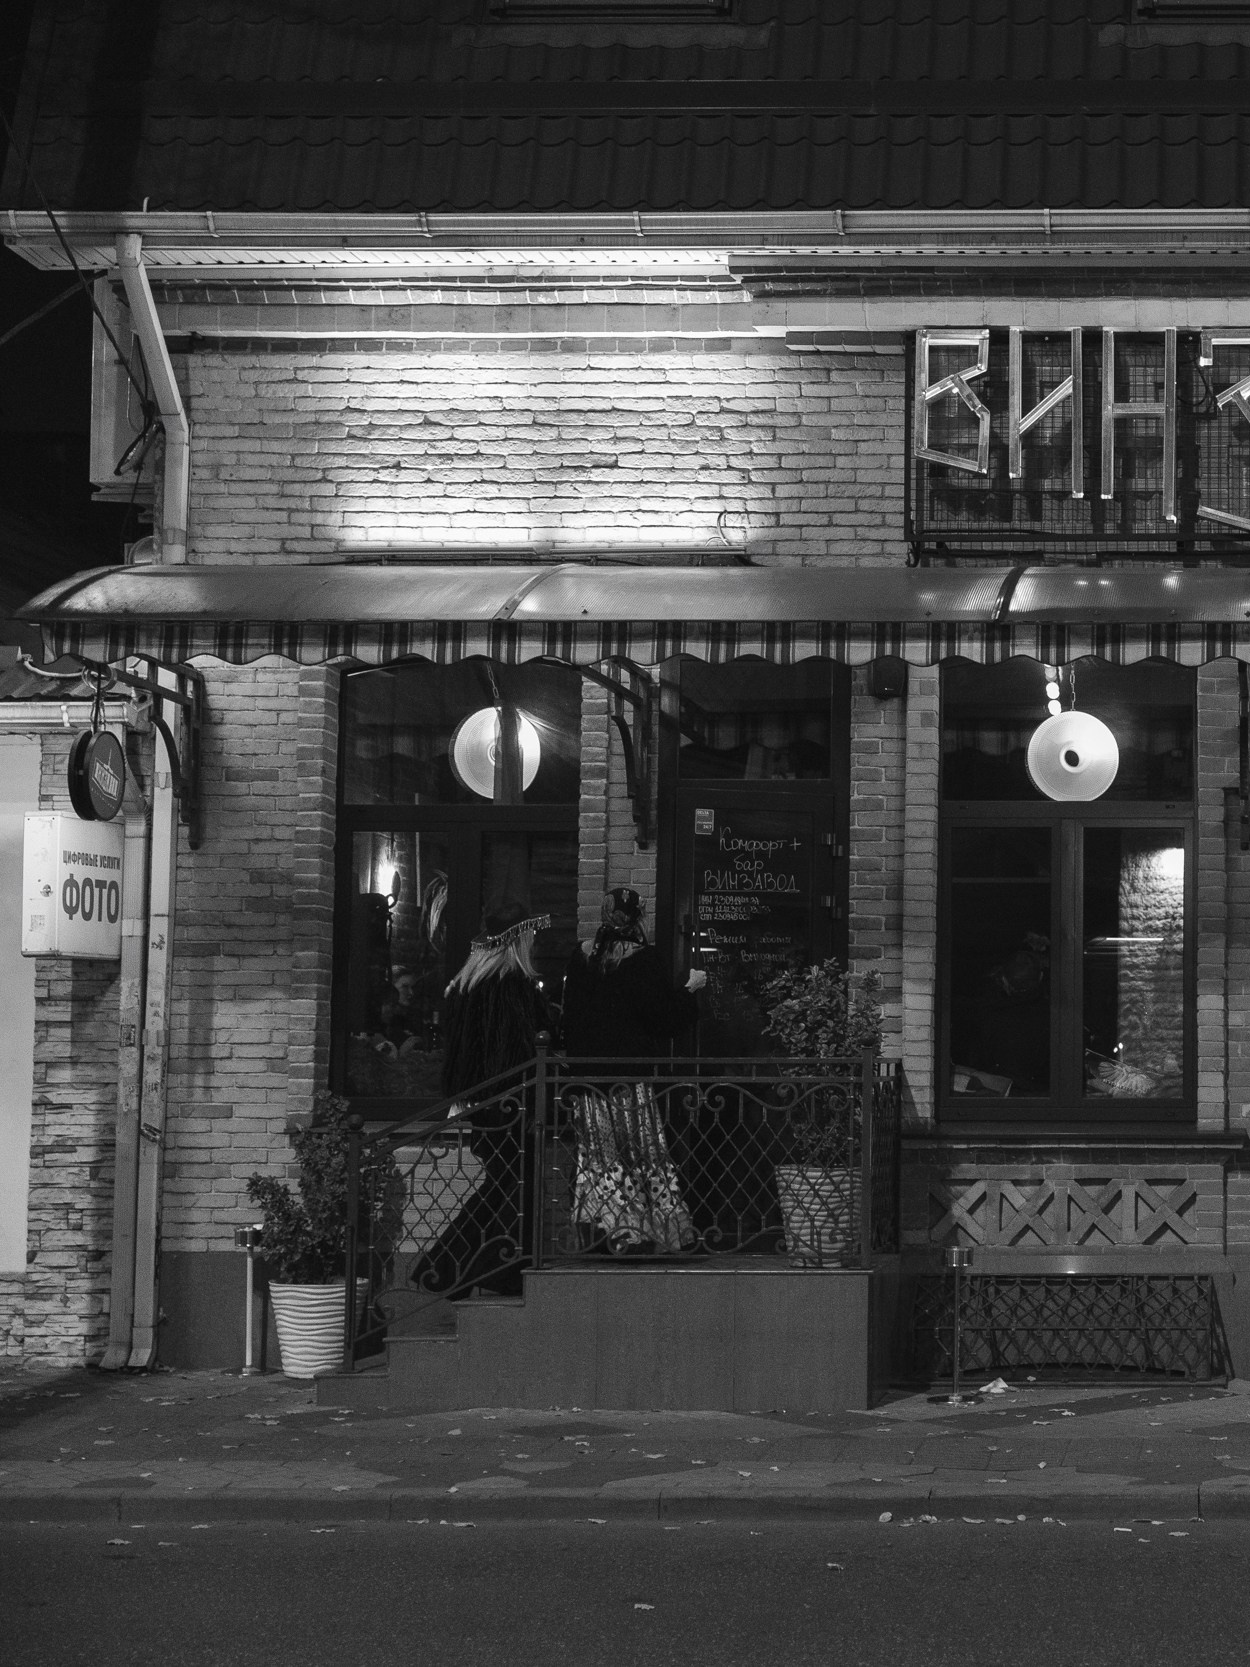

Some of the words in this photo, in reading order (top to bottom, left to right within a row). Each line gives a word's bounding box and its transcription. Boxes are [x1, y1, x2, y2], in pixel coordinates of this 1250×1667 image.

[720, 827, 787, 858] Комфорт
[62, 850, 98, 868] ЦИФРОВЫЕ
[99, 856, 120, 870] УСЛУГИ
[704, 870, 796, 891] ВИНЗАВОД
[61, 873, 120, 924] ФОТО
